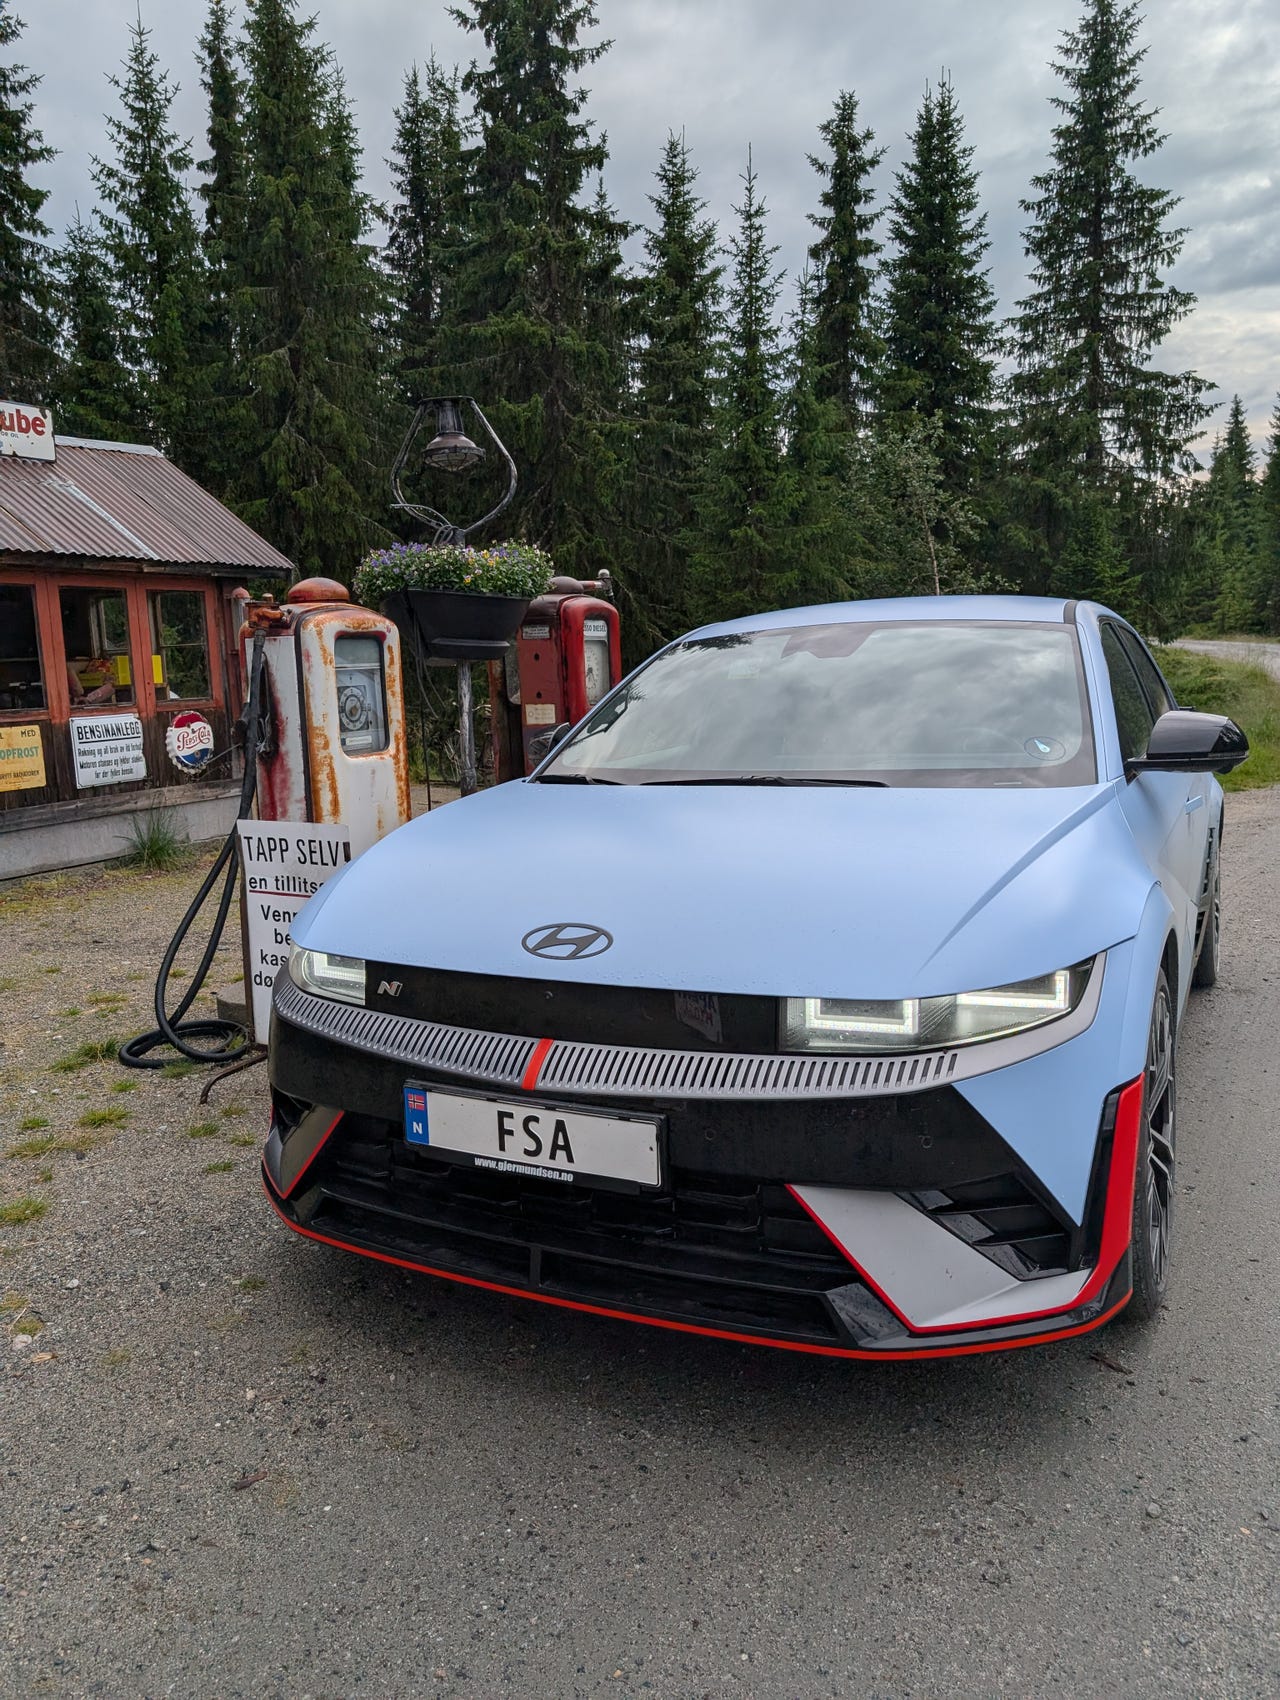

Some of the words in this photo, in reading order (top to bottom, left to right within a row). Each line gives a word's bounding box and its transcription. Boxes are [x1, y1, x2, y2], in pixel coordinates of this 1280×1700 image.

[21, 729, 36, 738] MED
[0, 746, 39, 760] OPFROST
[243, 836, 289, 863] TAPP
[249, 876, 268, 890] en
[412, 1121, 423, 1135] N
[497, 1110, 575, 1164] FSA
[474, 1157, 574, 1182] www.gjermundsen.no
